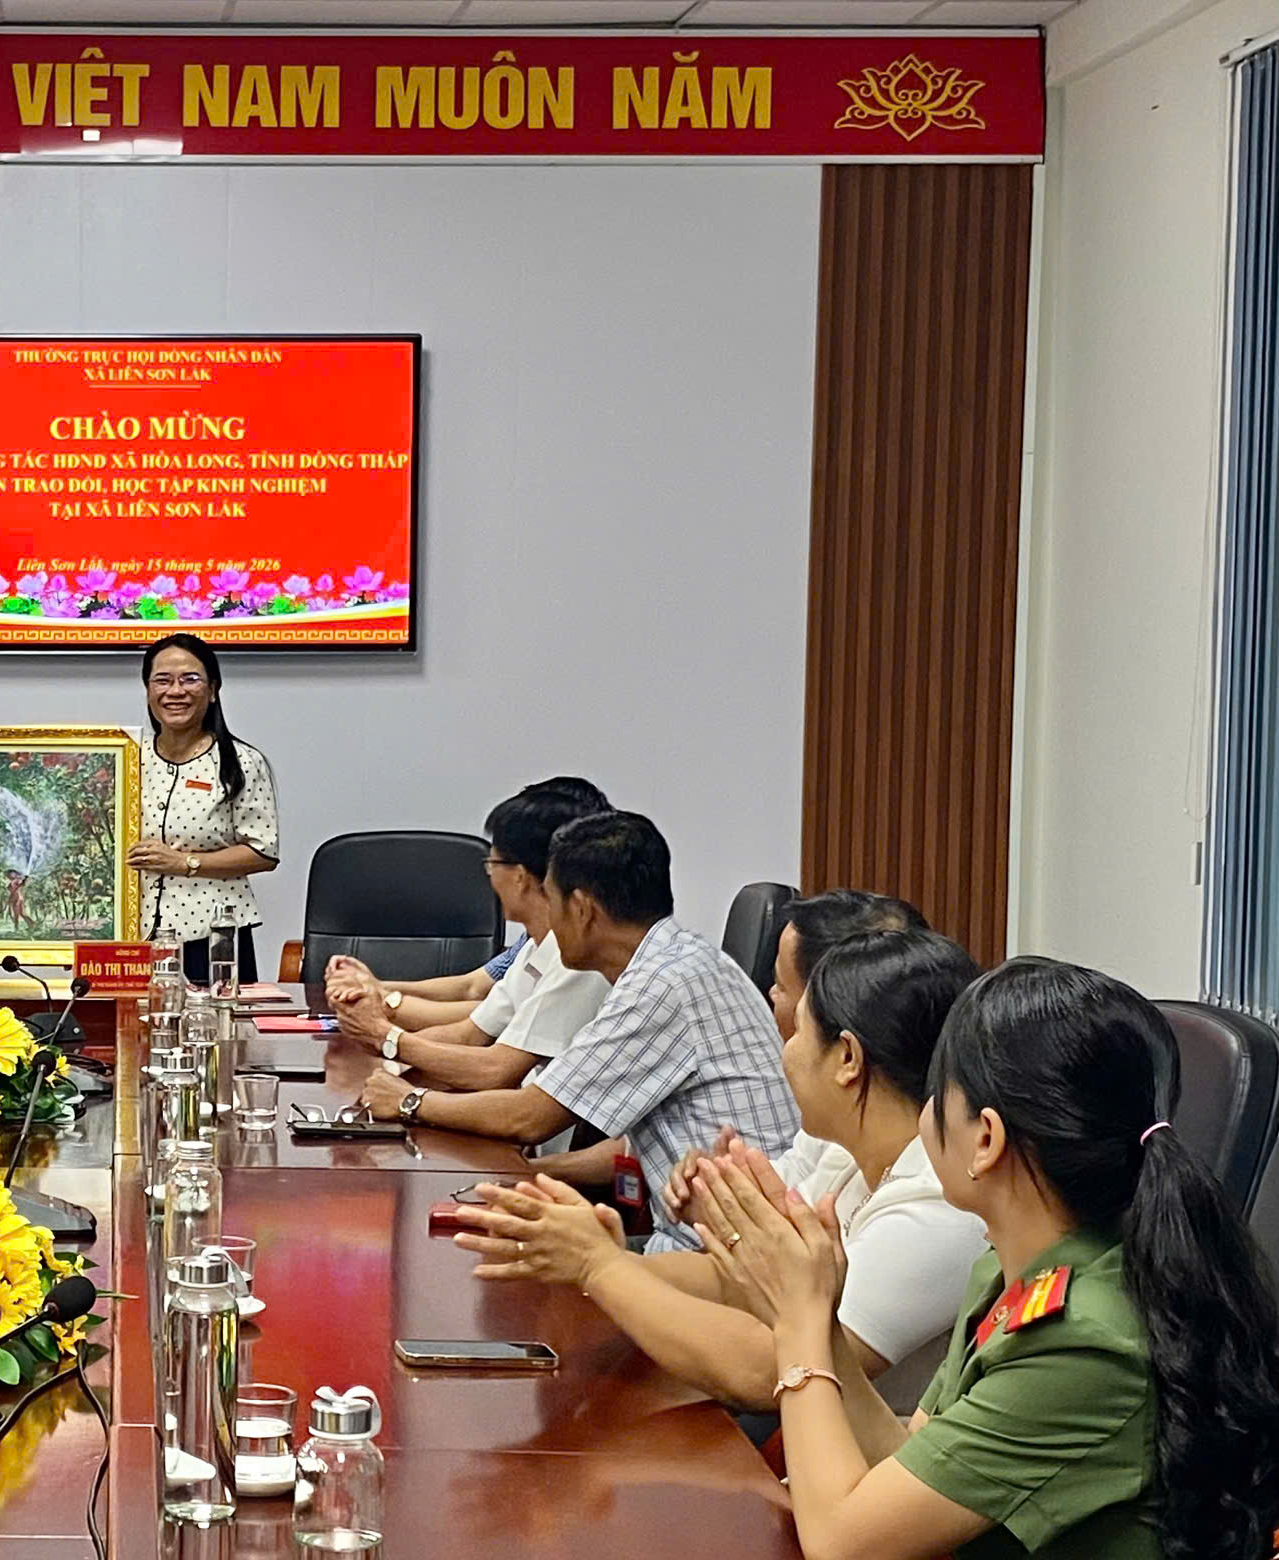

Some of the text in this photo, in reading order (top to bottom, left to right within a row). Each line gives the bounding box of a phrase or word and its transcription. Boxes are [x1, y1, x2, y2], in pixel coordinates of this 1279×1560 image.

[12, 48, 149, 141] VIỆT
[183, 65, 340, 128] NAM
[375, 50, 574, 130] MUÔN
[613, 52, 772, 130] NĂM
[205, 348, 247, 364] NHÂN
[84, 367, 105, 381] XÃ
[109, 366, 143, 381] LIÊN
[146, 368, 176, 381] SƠN
[49, 410, 246, 441] CHÀO MỪNG
[10, 450, 49, 469] TÁC
[111, 451, 137, 469] XÃ
[142, 450, 182, 469] HÒA
[187, 453, 245, 470] LONG,
[249, 451, 295, 469] TỈNH
[359, 450, 409, 469] THÁP
[11, 478, 65, 493] TRAO
[112, 478, 152, 496] HỌC
[197, 478, 245, 493] KINH
[250, 476, 327, 496] NGHIỆM
[49, 502, 81, 520] TẠI
[86, 499, 111, 517] XÃ
[117, 499, 160, 517] LIÊN
[164, 501, 202, 517] SƠN
[17, 558, 46, 571] Liên
[49, 558, 76, 571] Sơn
[111, 559, 143, 574] ngày
[147, 559, 162, 571] 15
[165, 558, 202, 574] tháng
[205, 559, 214, 571] 5
[249, 558, 281, 571] 2026
[123, 962, 152, 976] THAN
